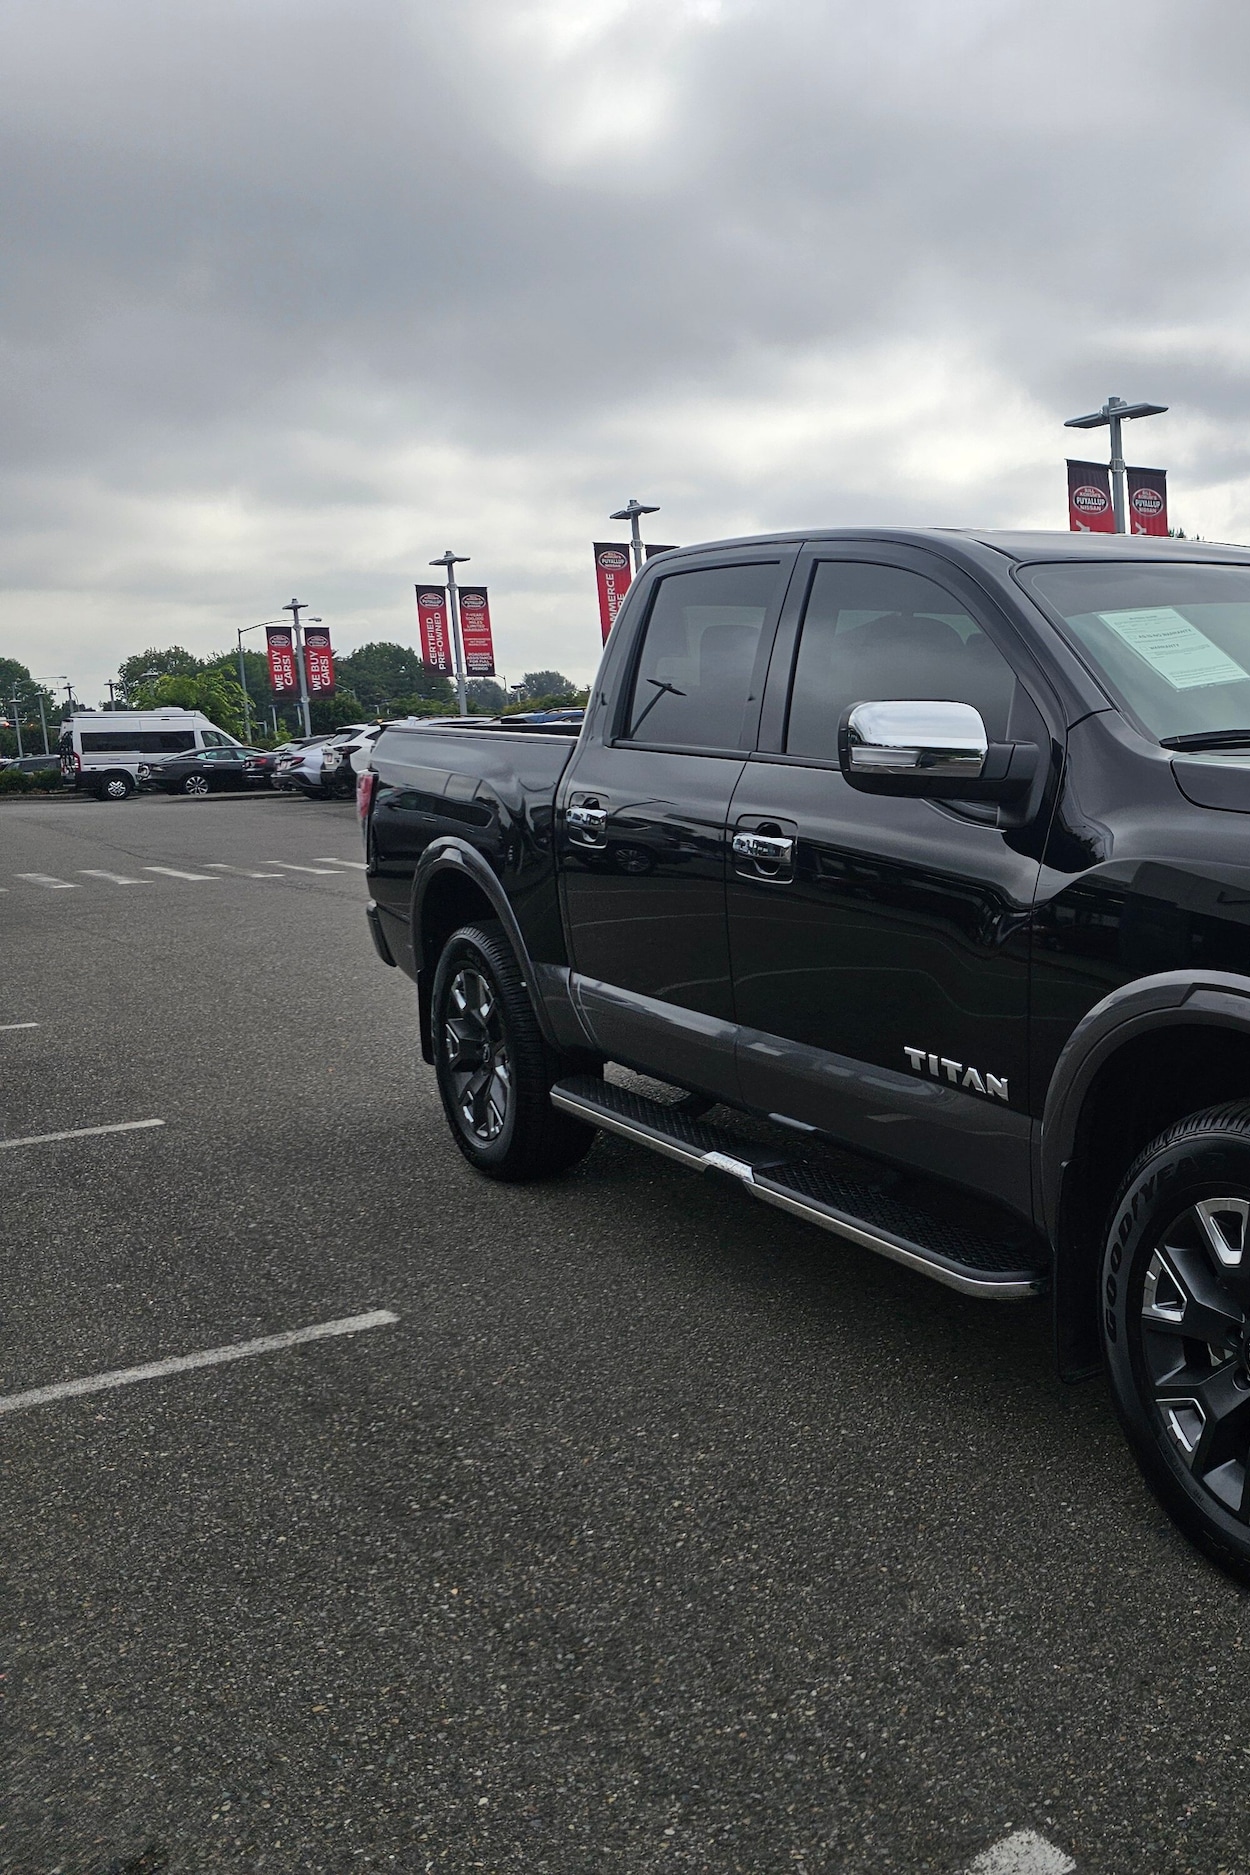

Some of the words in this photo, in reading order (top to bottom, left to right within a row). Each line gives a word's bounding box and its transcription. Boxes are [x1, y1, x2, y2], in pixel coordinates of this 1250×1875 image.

[1076, 497, 1105, 506] PUYALLUP
[1136, 500, 1160, 508] PUYALLUP
[426, 618, 438, 665] CERTIFIED
[434, 612, 446, 670] PRE-OWNED
[272, 650, 282, 672] BUY
[282, 656, 293, 686] CARS!
[310, 650, 320, 672] BUY
[320, 656, 330, 686] CARS!
[274, 674, 284, 690] WE
[312, 674, 322, 690] WE
[904, 1046, 1009, 1102] TITAN
